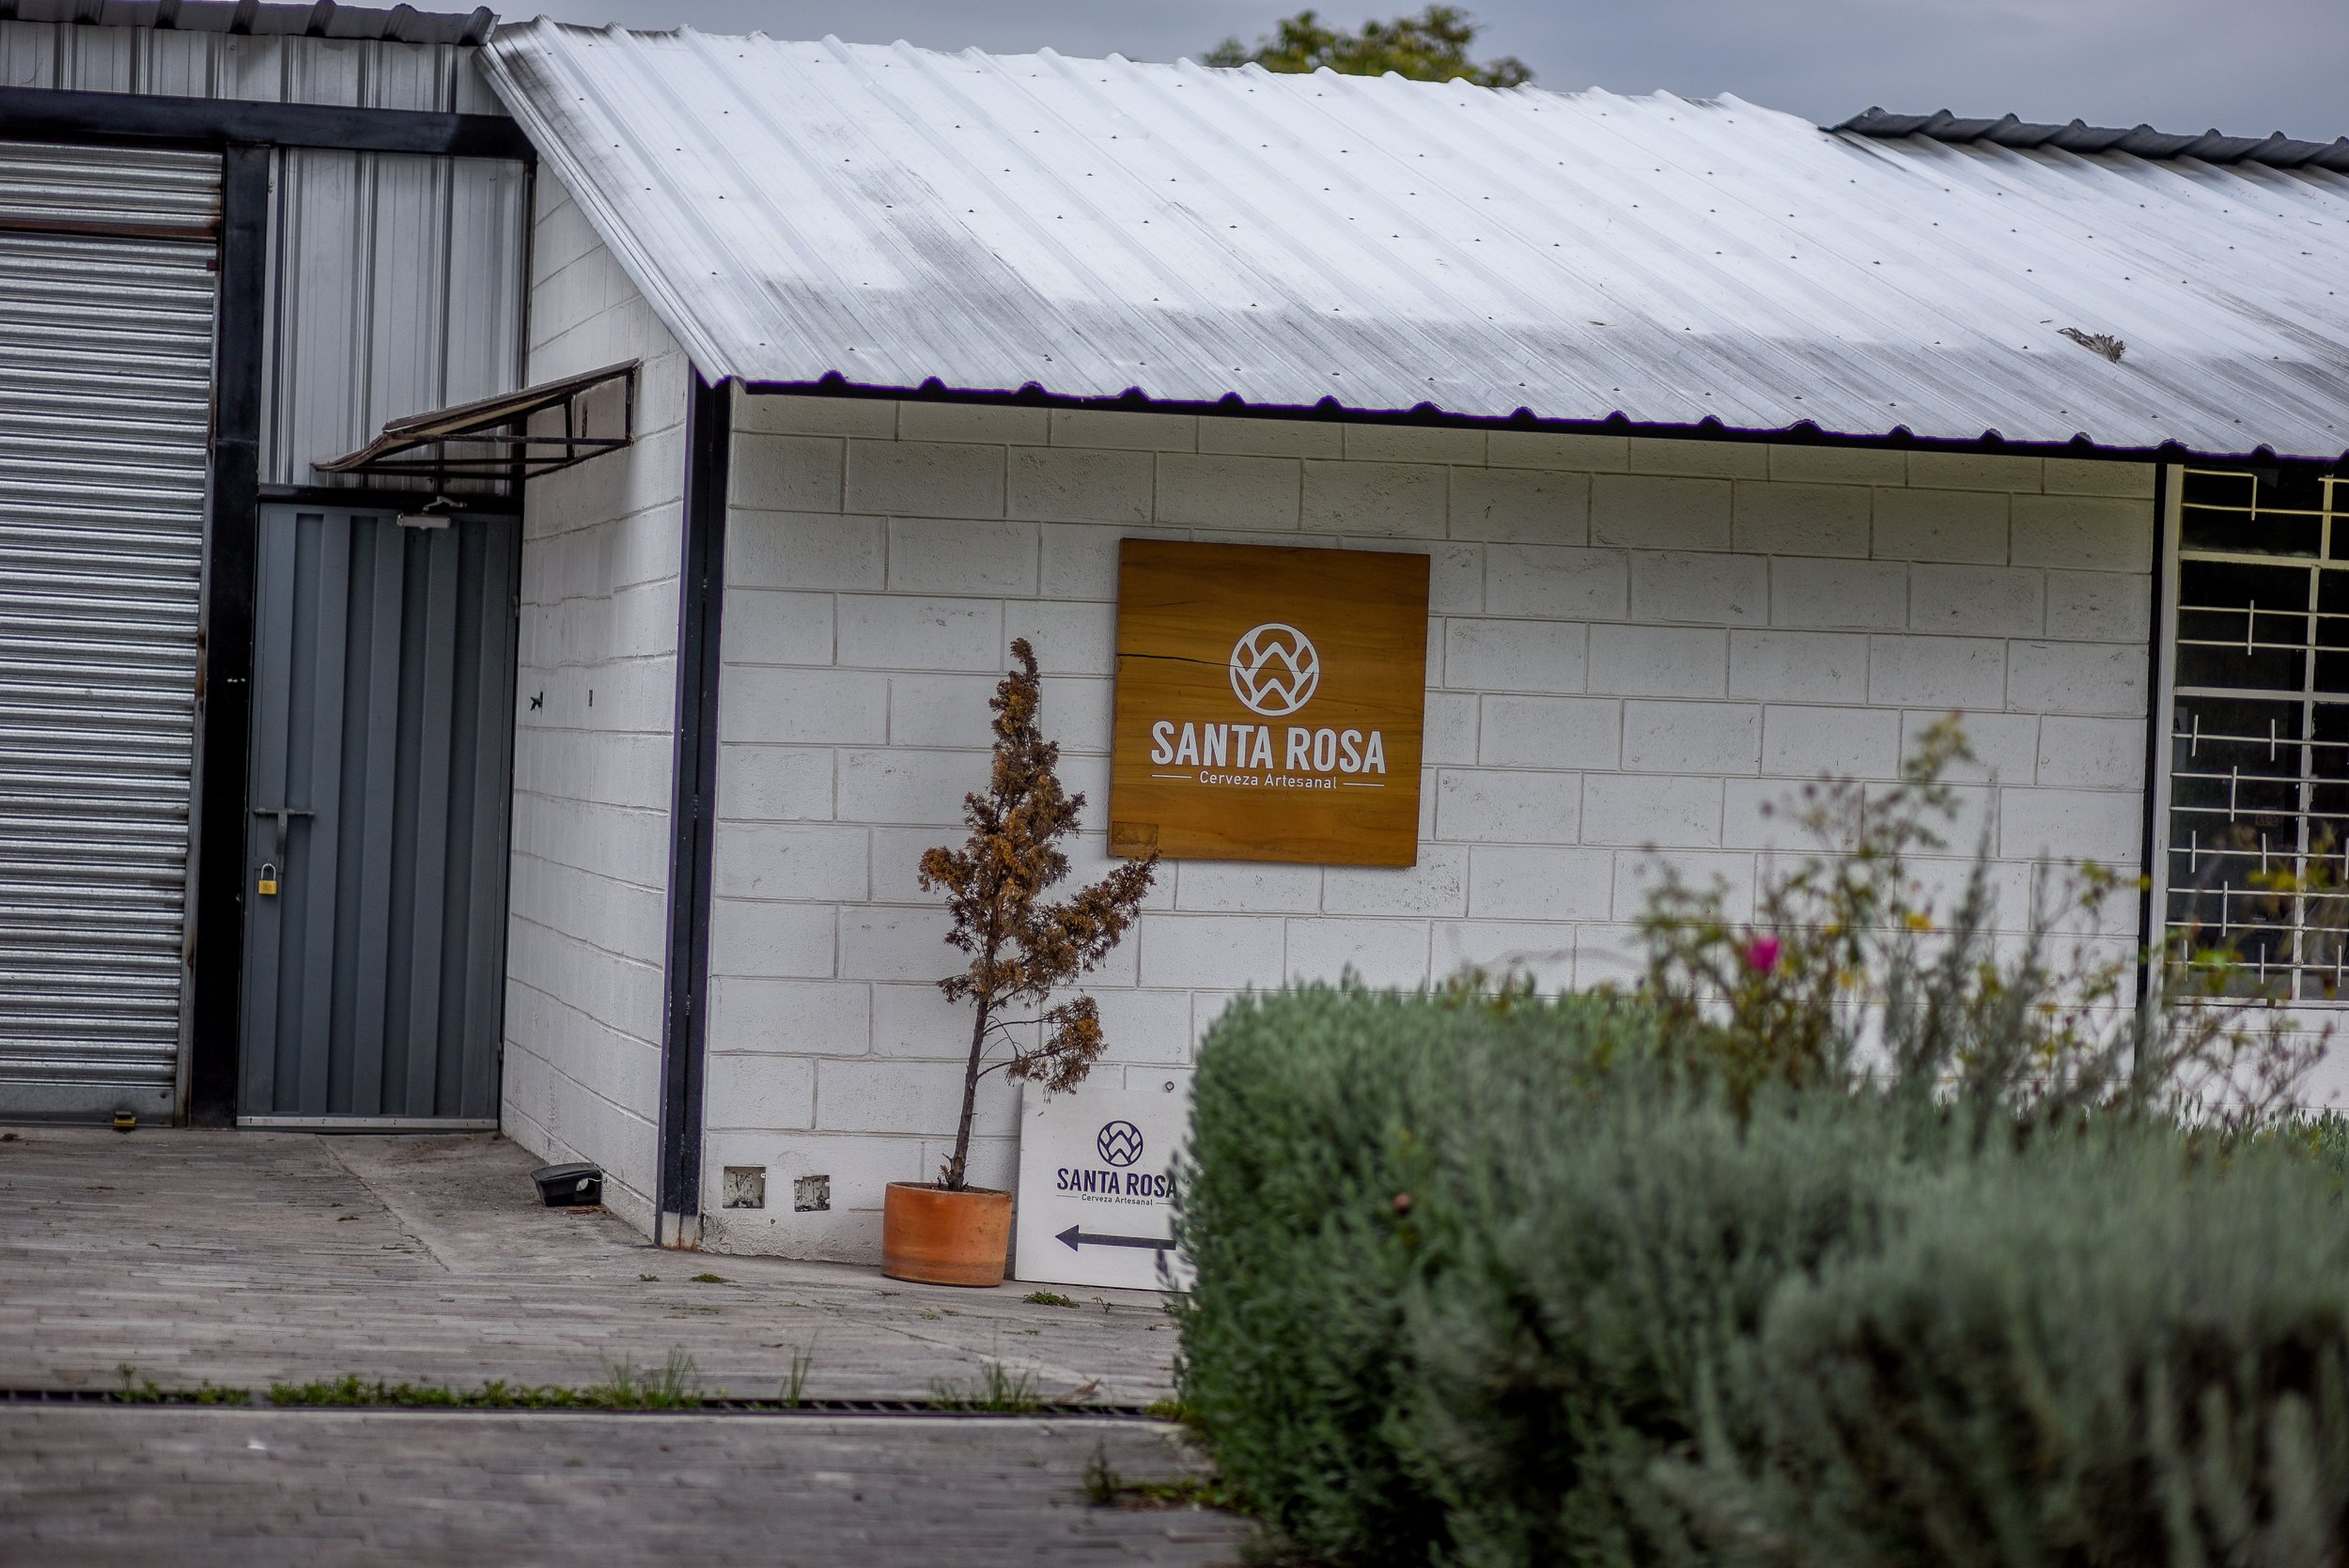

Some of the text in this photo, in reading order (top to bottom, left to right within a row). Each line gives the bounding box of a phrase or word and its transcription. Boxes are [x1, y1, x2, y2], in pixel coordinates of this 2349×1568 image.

[1151, 721, 1386, 774] SANTA ROSA
[1199, 770, 1337, 789] Cerveza Artesanal
[1056, 1168, 1177, 1198] SANTA ROSA
[1081, 1193, 1153, 1205] Cerveza Artesanal
